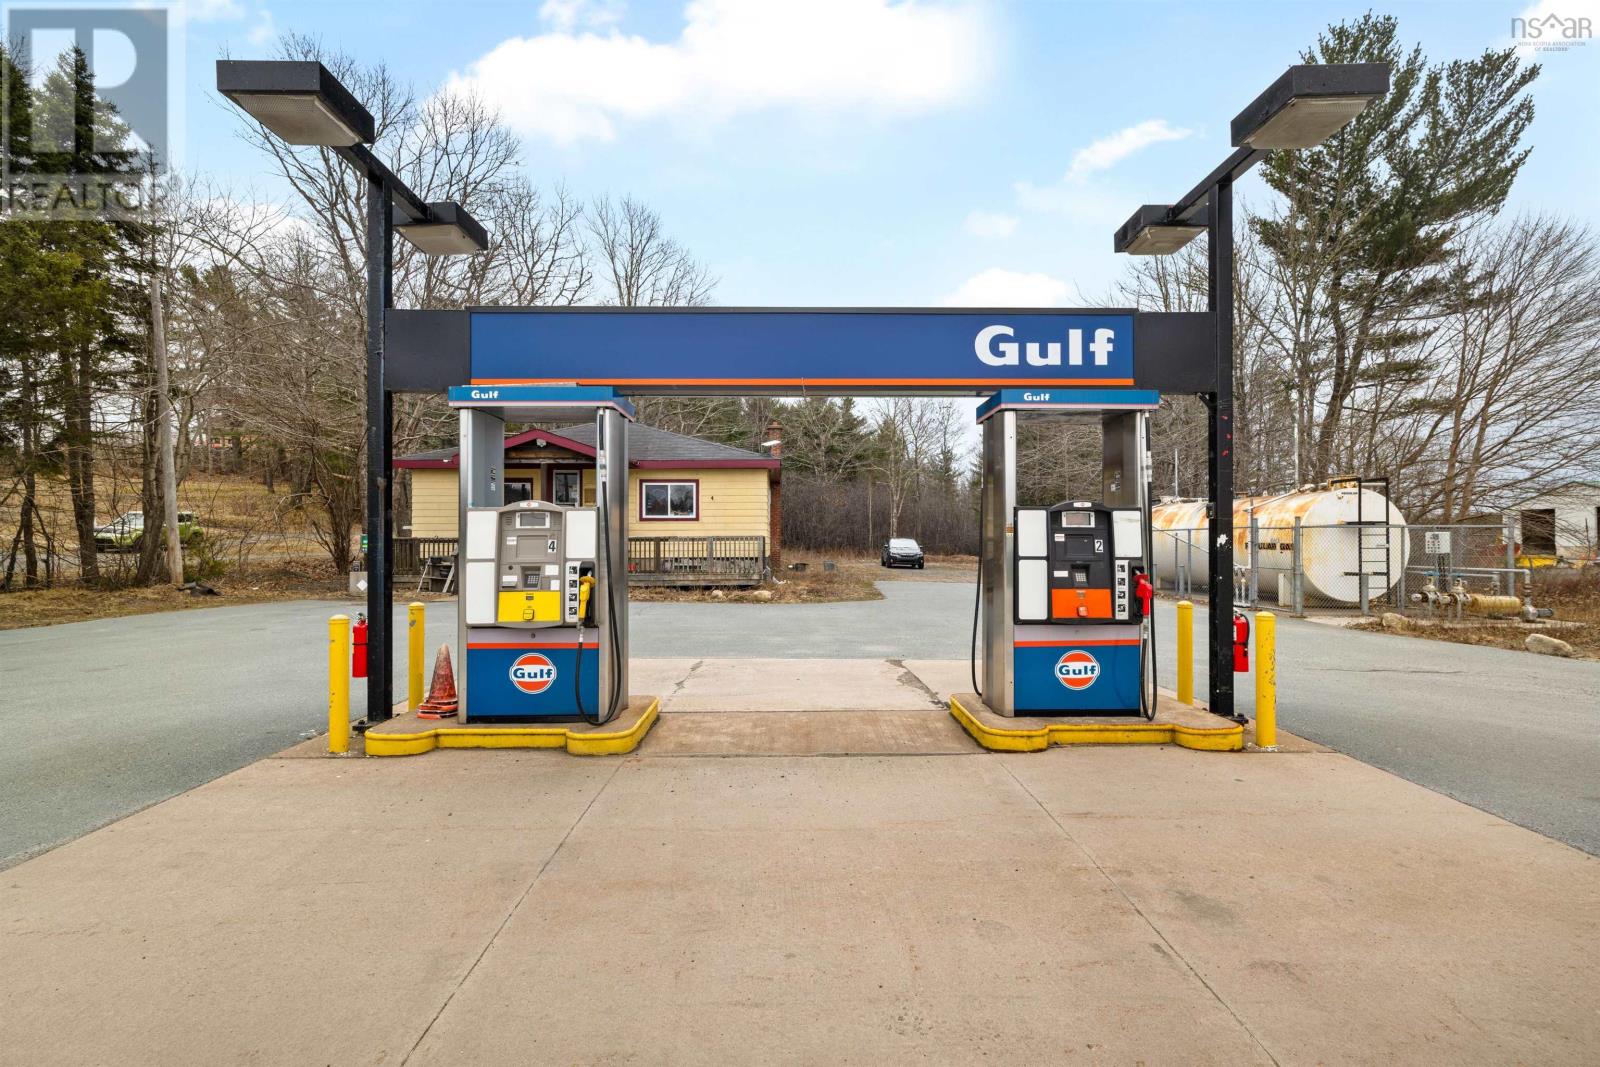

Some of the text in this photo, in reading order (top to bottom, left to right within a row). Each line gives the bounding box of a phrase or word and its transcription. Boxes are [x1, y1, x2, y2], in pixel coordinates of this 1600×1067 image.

[974, 324, 1115, 367] Gulf
[471, 390, 499, 399] Gulf
[1023, 392, 1050, 401] Gulf
[548, 540, 556, 552] 4
[1096, 540, 1103, 552] 2
[513, 667, 554, 679] Gulf
[1058, 664, 1097, 676] Gulf
